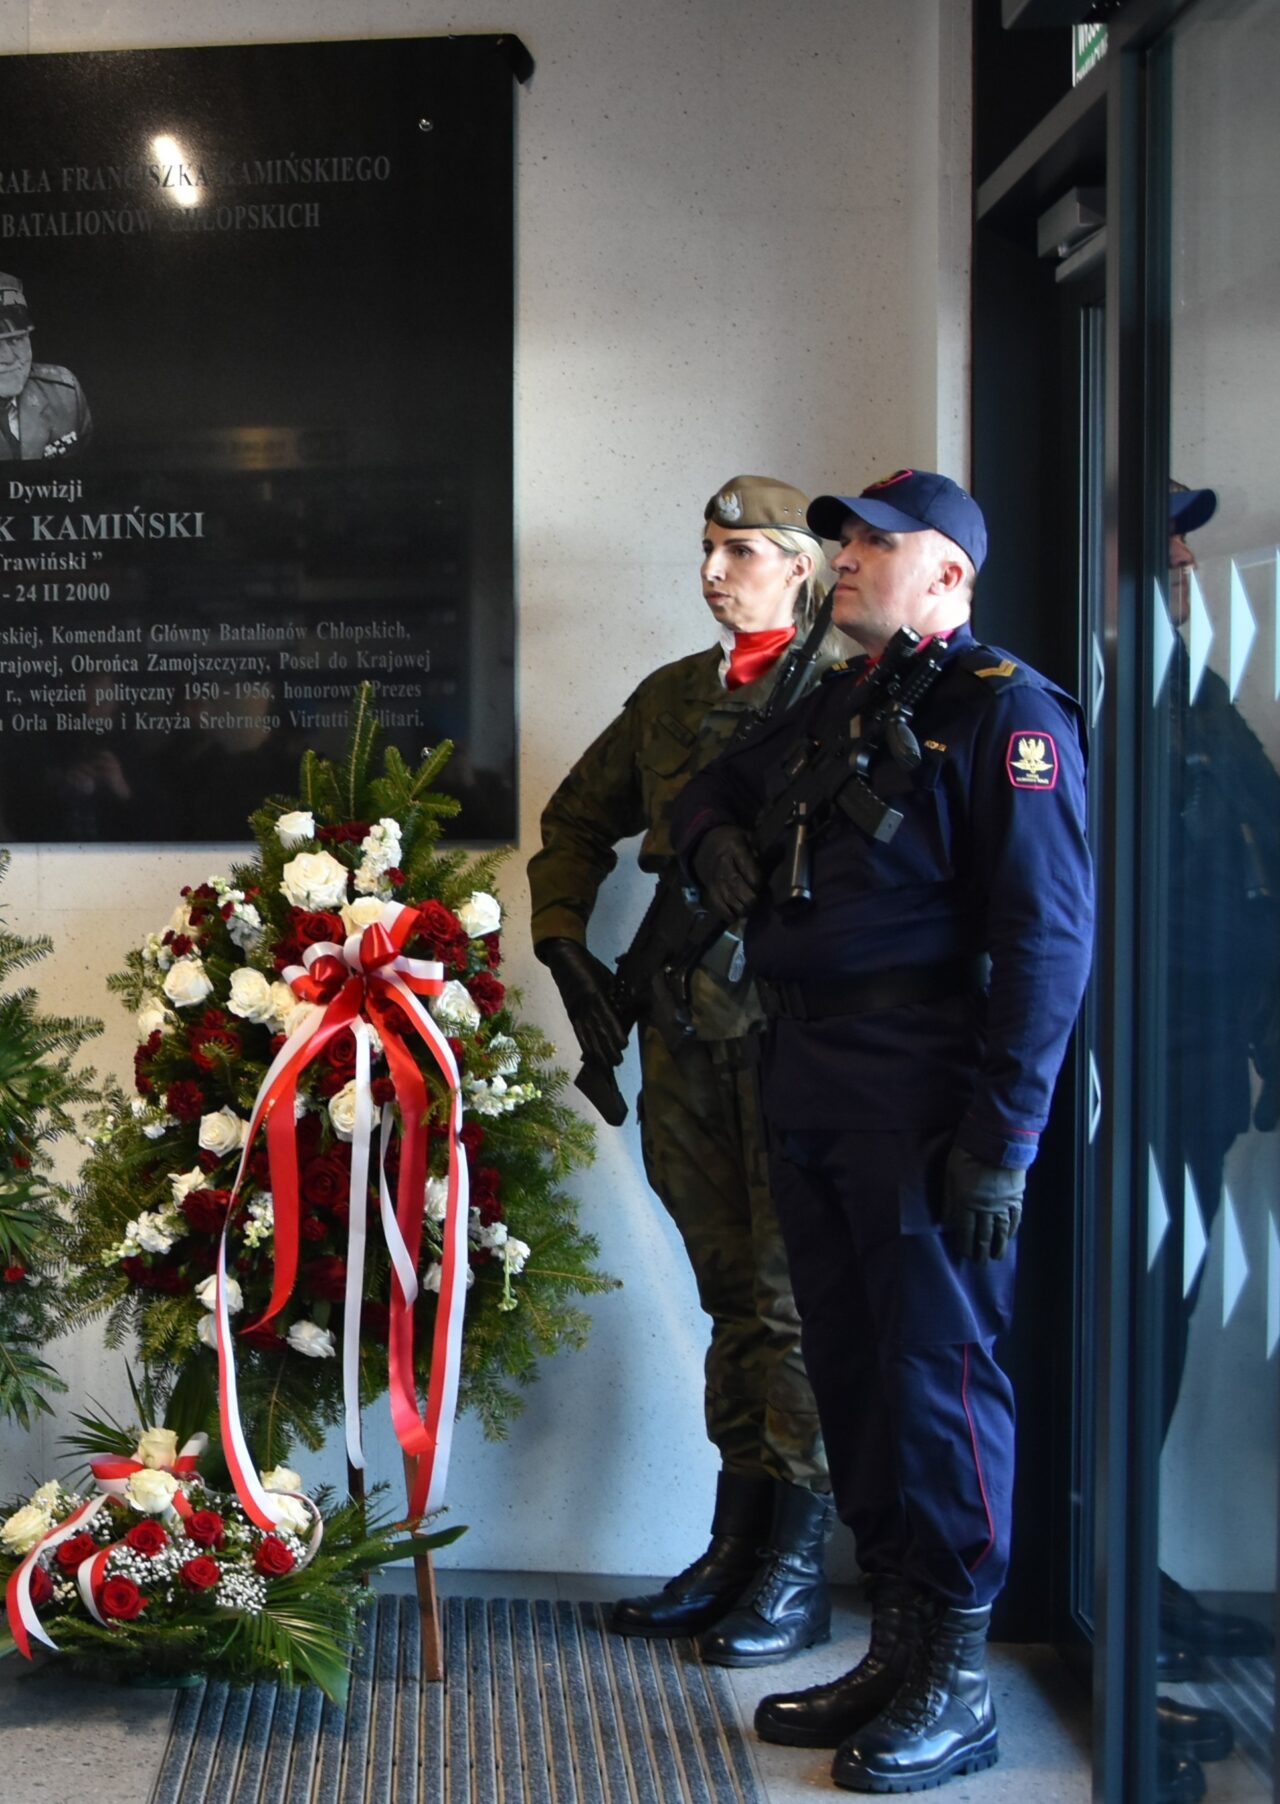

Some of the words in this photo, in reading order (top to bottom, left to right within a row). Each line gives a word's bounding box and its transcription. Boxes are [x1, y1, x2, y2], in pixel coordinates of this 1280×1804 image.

[221, 152, 392, 186] KAMIŃSKIEGO
[2, 202, 154, 239] BATALIONÓW
[168, 202, 320, 233] CHŁOPSKICH
[9, 480, 83, 503] Dywizji
[31, 505, 206, 541] KAMIŃSKI
[16, 584, 37, 602] 24
[43, 583, 59, 601] II
[65, 583, 110, 602] 2000
[52, 625, 142, 645] Komendant
[150, 623, 211, 646] Główny
[220, 622, 308, 642] Batalionów
[71, 654, 139, 673] Obrońca
[147, 653, 271, 676] Zamojszczyzny,
[279, 651, 320, 670] Poseł
[328, 651, 348, 669] do
[356, 650, 431, 673] Krajowej
[30, 684, 87, 707] więzień
[95, 682, 175, 706] polityczny
[184, 681, 220, 701] 1950
[234, 681, 276, 702] 1956,
[371, 679, 422, 698] Prezes
[12, 713, 48, 732] Orła
[56, 712, 114, 735] Białego
[121, 712, 127, 730] i
[135, 710, 192, 734] Krzyża
[199, 710, 281, 732] Srebrnego
[289, 709, 350, 729] Virtutti
